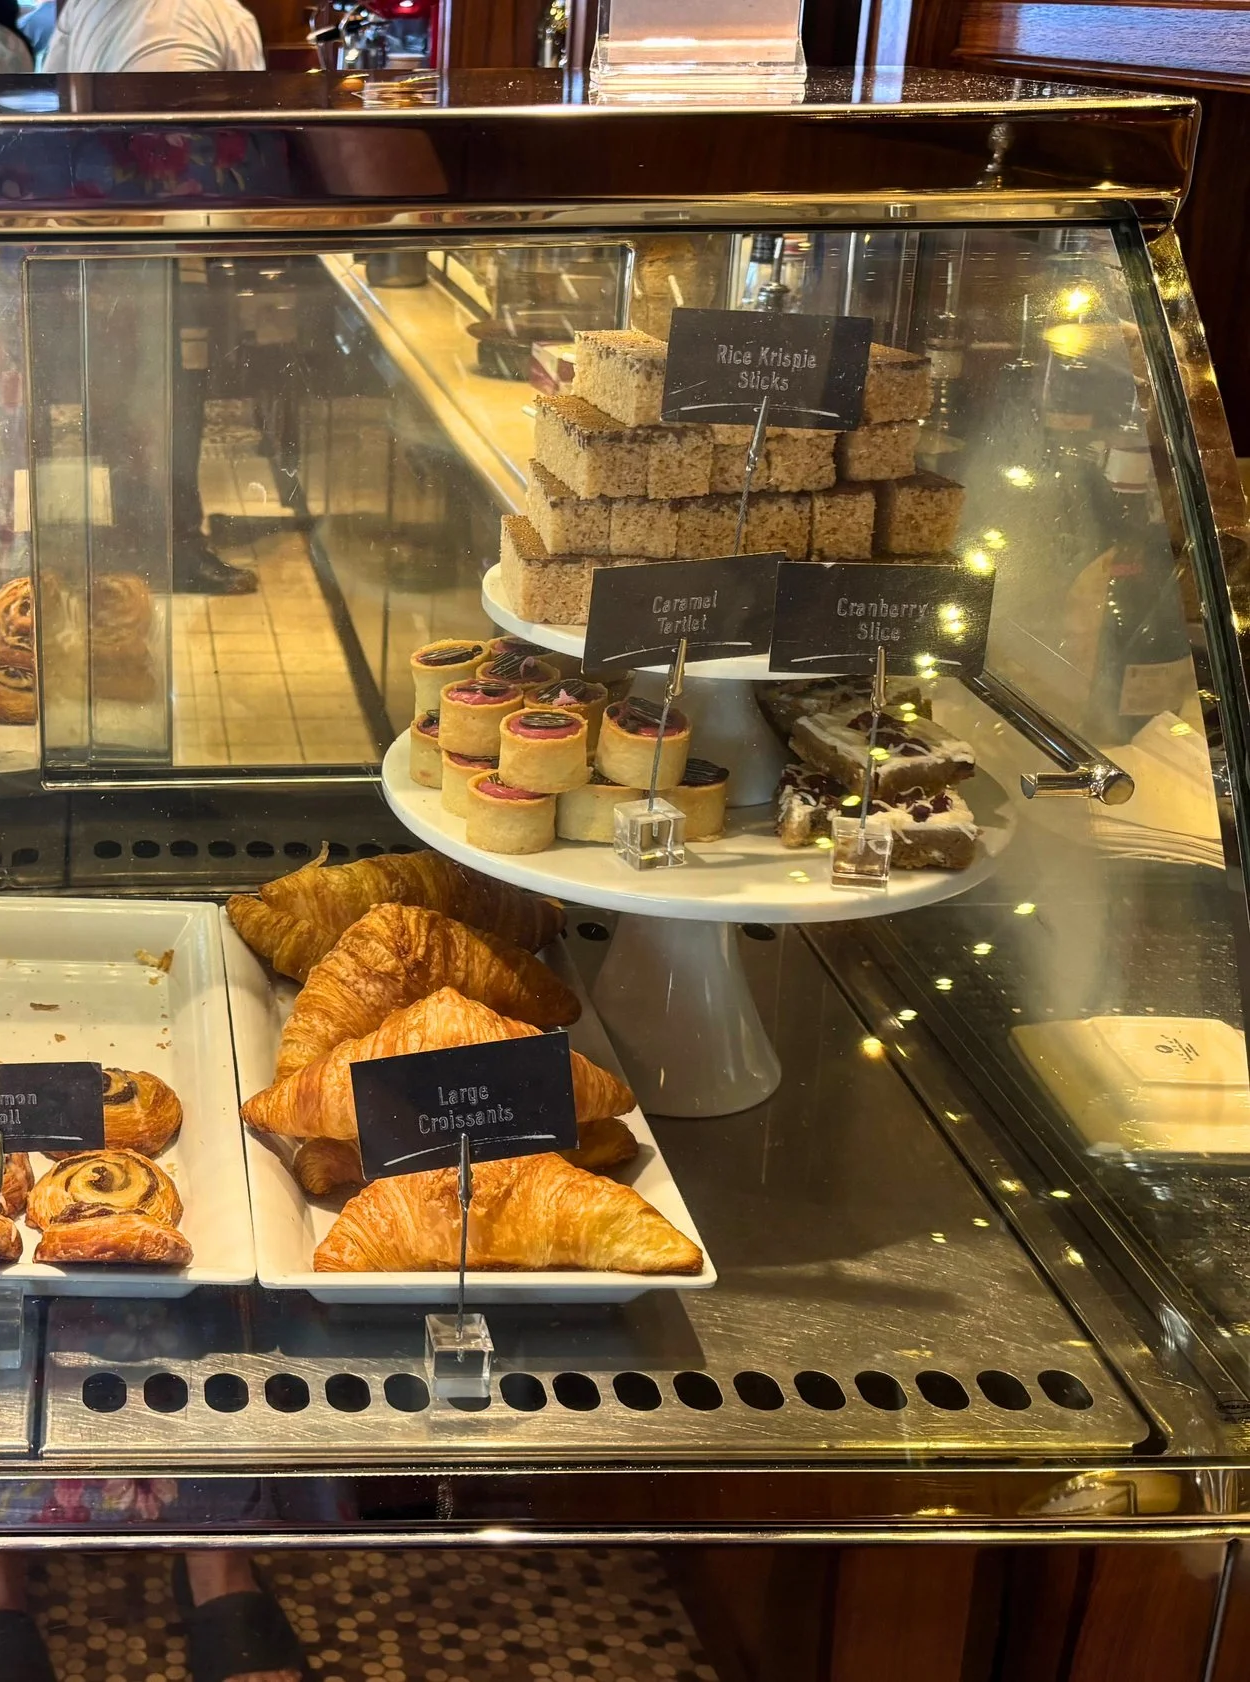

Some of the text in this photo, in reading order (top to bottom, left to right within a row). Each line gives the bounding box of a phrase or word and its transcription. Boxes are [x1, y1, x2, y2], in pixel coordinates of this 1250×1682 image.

[716, 344, 817, 372] Rice Krispie
[737, 370, 789, 391] Sticks
[652, 590, 718, 613] Caramel
[836, 597, 929, 621] Cranberry
[657, 614, 707, 634] Tartlet
[856, 621, 901, 641] Slice
[437, 1084, 490, 1106] Large
[417, 1104, 515, 1134] Croissants
